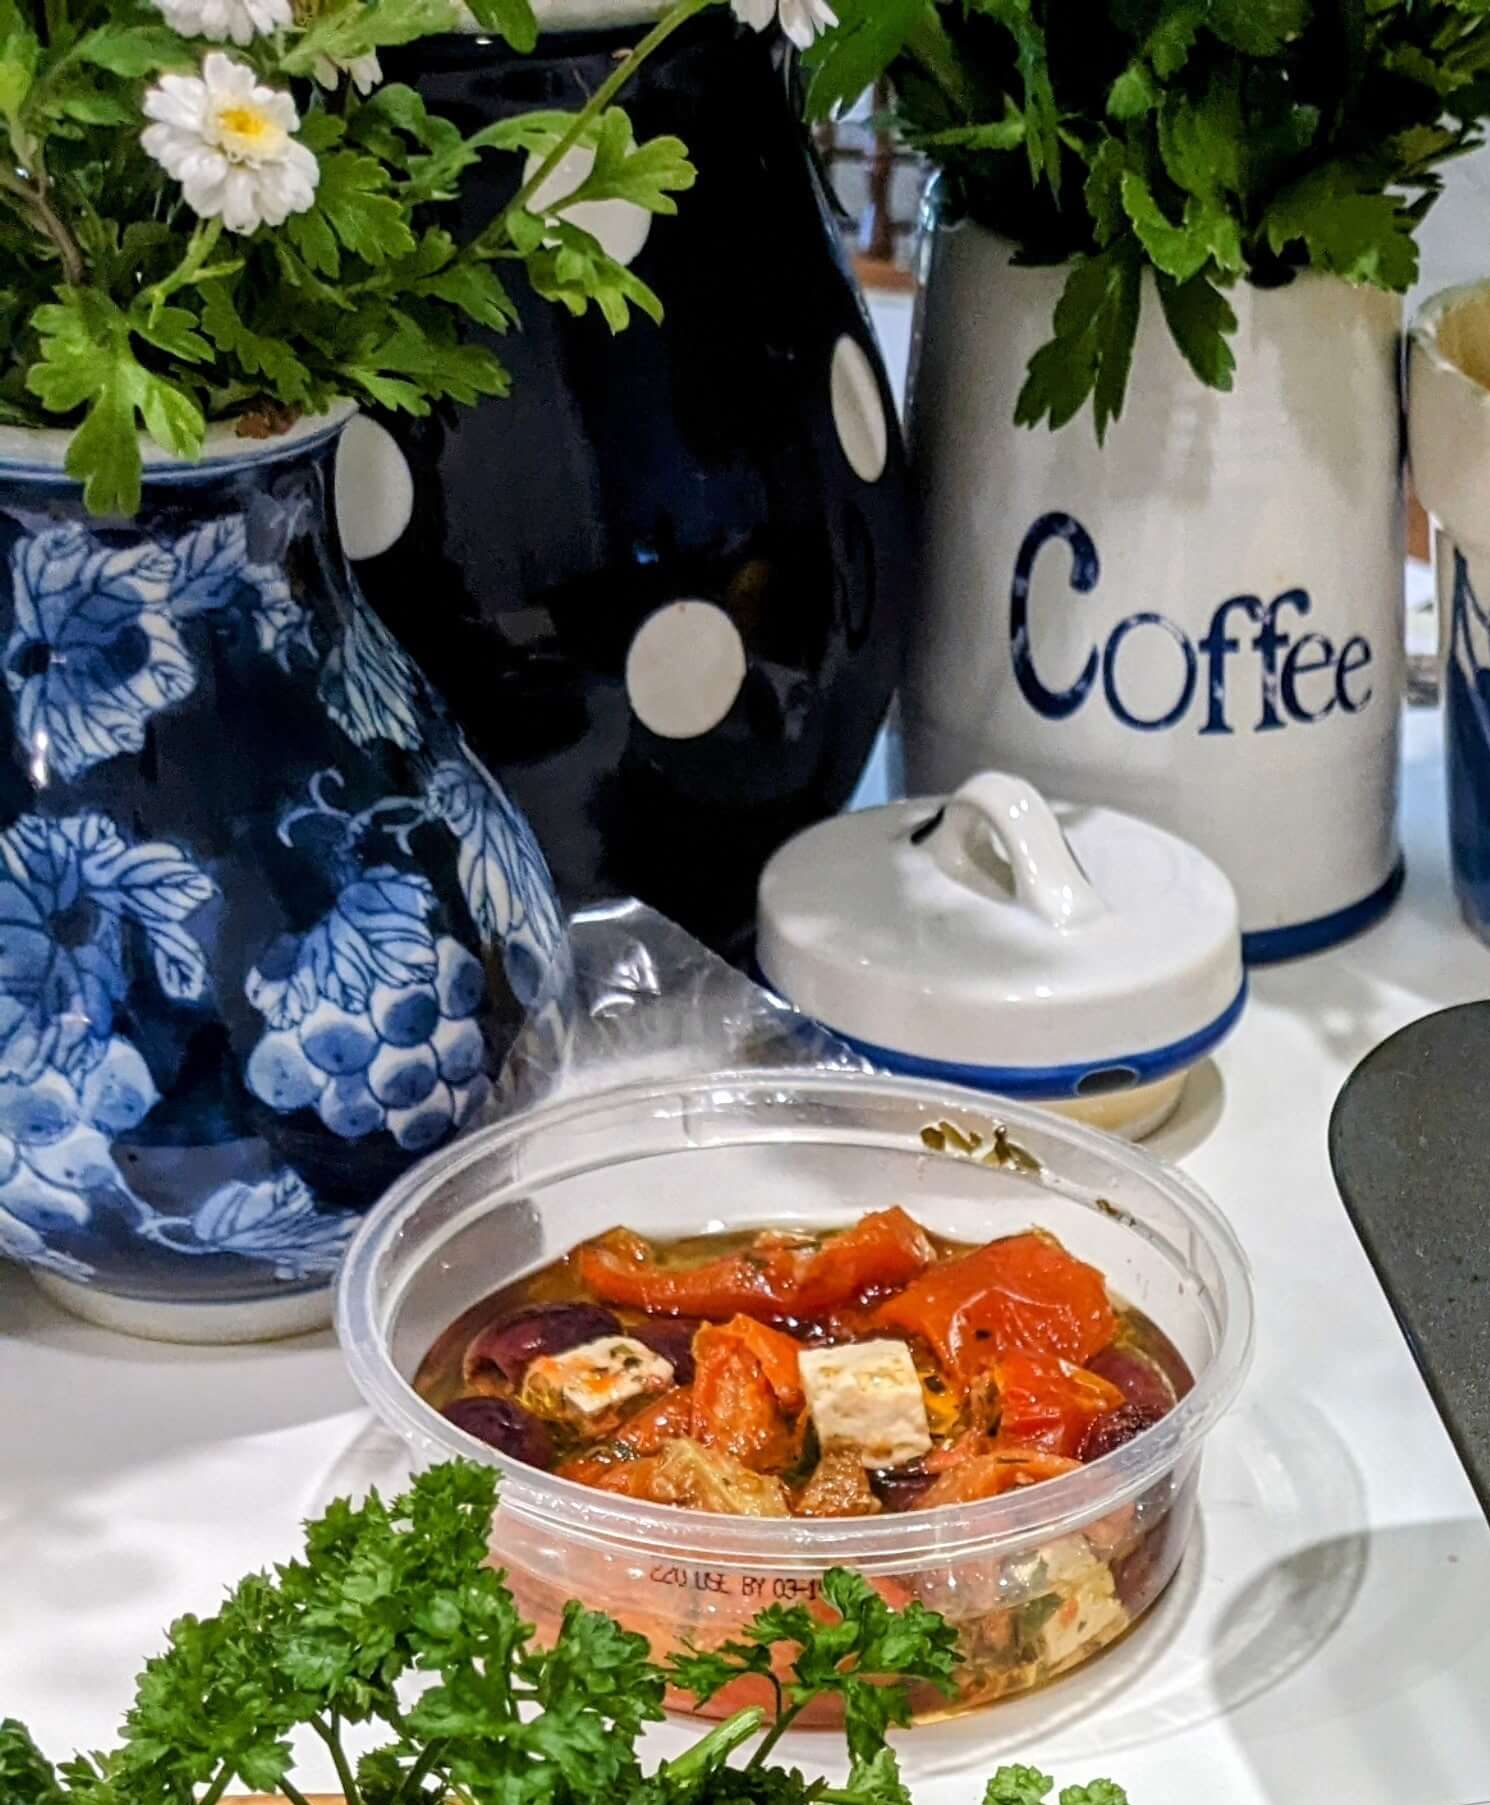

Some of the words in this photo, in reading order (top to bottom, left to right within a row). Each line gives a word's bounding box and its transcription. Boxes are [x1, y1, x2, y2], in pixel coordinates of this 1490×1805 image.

[1010, 511, 1373, 735] Coffee
[694, 1570, 731, 1595] USE
[742, 1575, 766, 1598] BY
